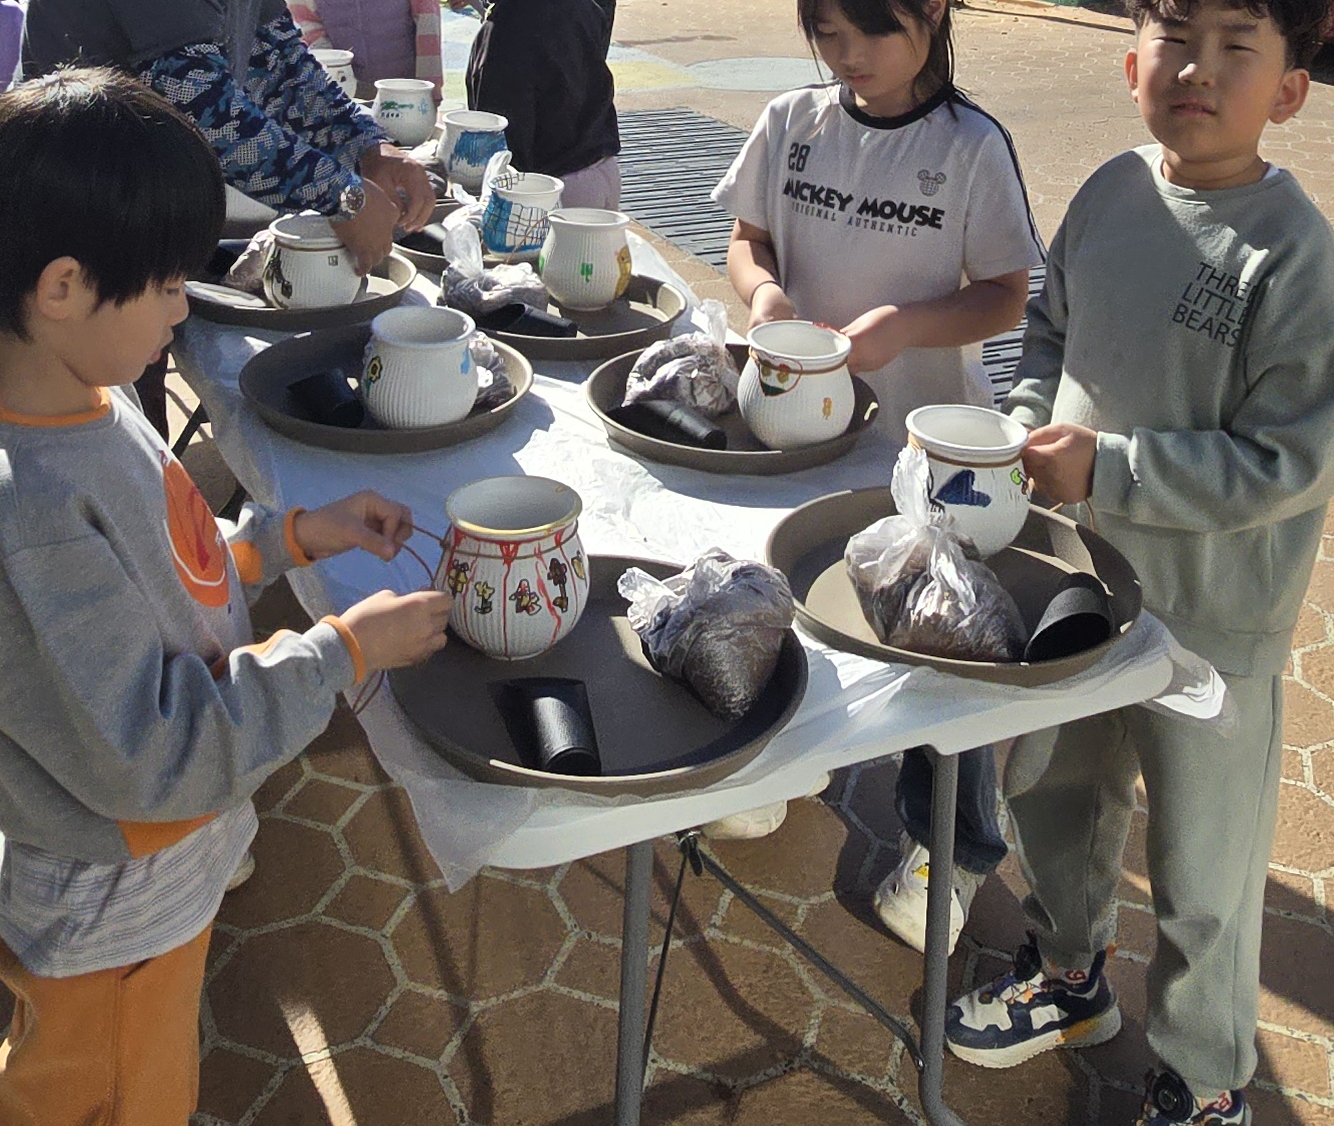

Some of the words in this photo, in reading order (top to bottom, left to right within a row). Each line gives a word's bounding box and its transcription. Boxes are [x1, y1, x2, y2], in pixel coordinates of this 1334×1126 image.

[787, 142, 811, 173] 28
[783, 177, 854, 212] MICKEY
[857, 196, 946, 230] MOUSE
[847, 215, 918, 237] AUTHENTIC
